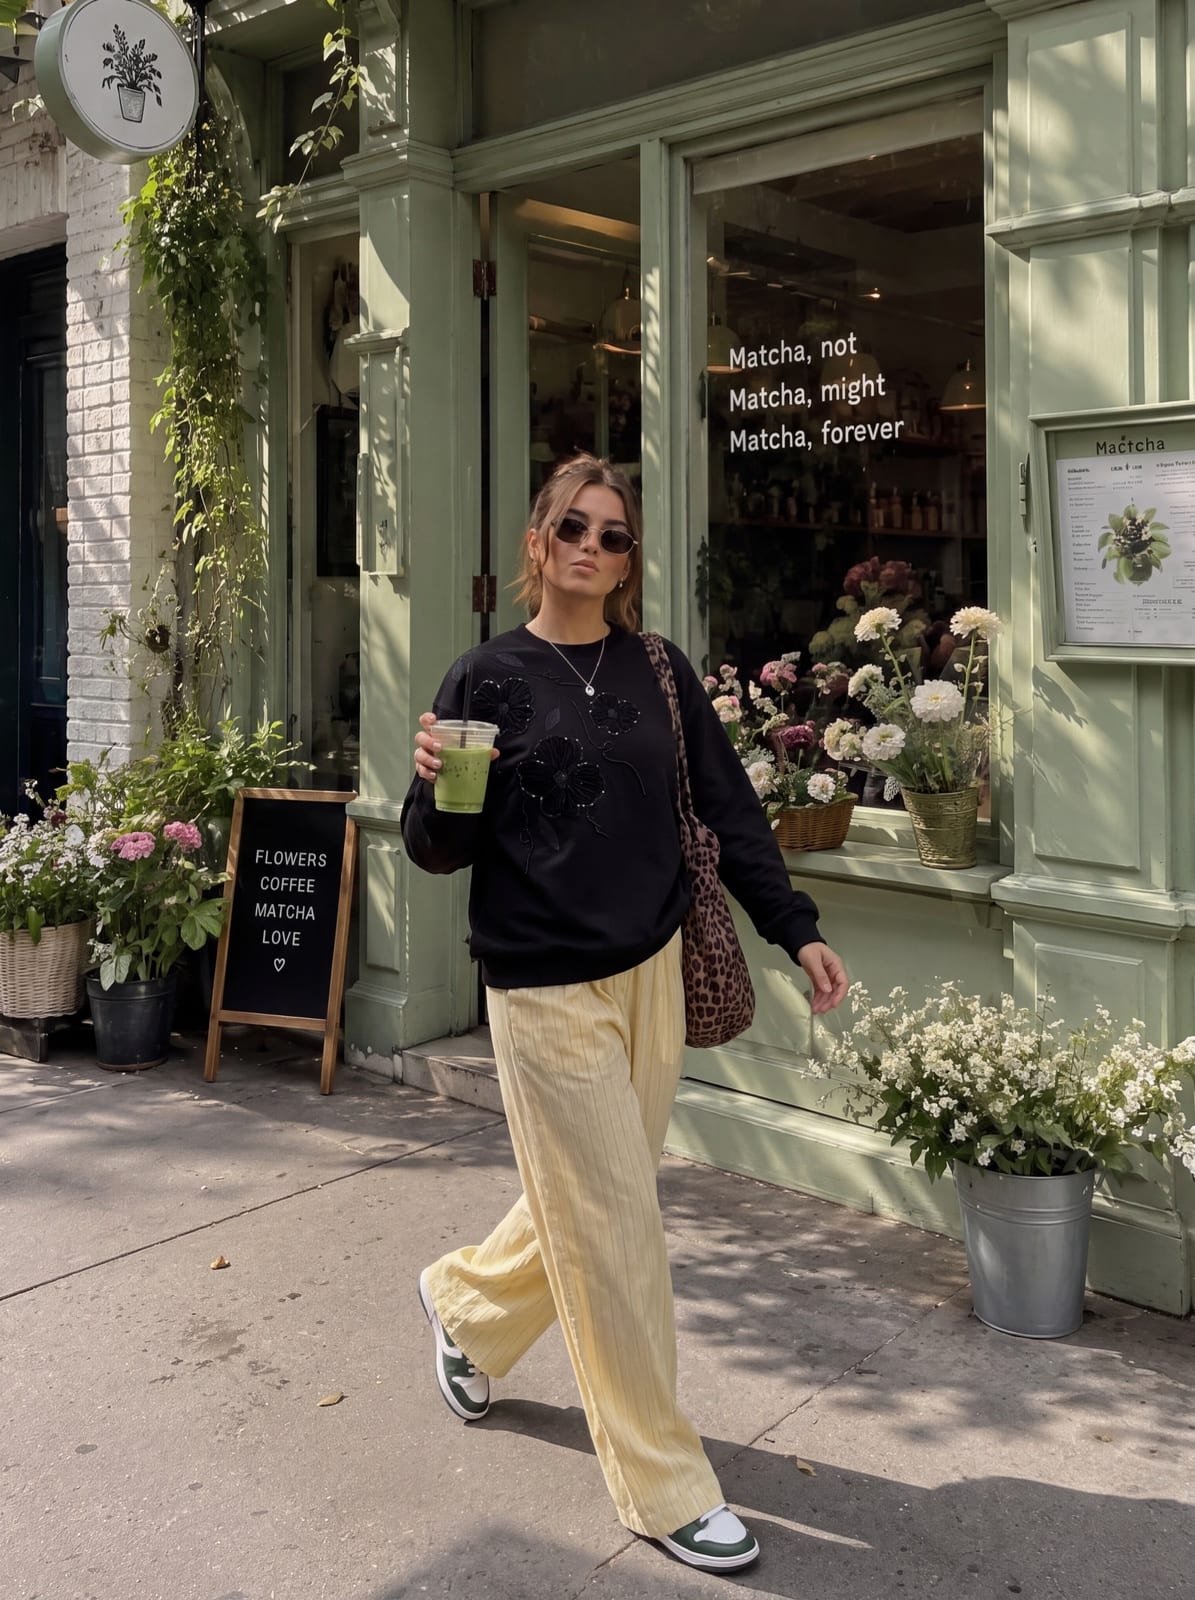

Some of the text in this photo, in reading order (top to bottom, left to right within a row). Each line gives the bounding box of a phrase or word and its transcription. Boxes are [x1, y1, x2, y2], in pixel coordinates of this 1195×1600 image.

[729, 332, 857, 370] Matcha, not
[729, 373, 886, 412] Matcha, might
[729, 420, 904, 453] Matcha, forever
[255, 849, 327, 867] FLOWERS
[260, 876, 316, 893] COFFEE
[254, 903, 316, 921] MATCHA
[262, 929, 302, 946] LOVE
